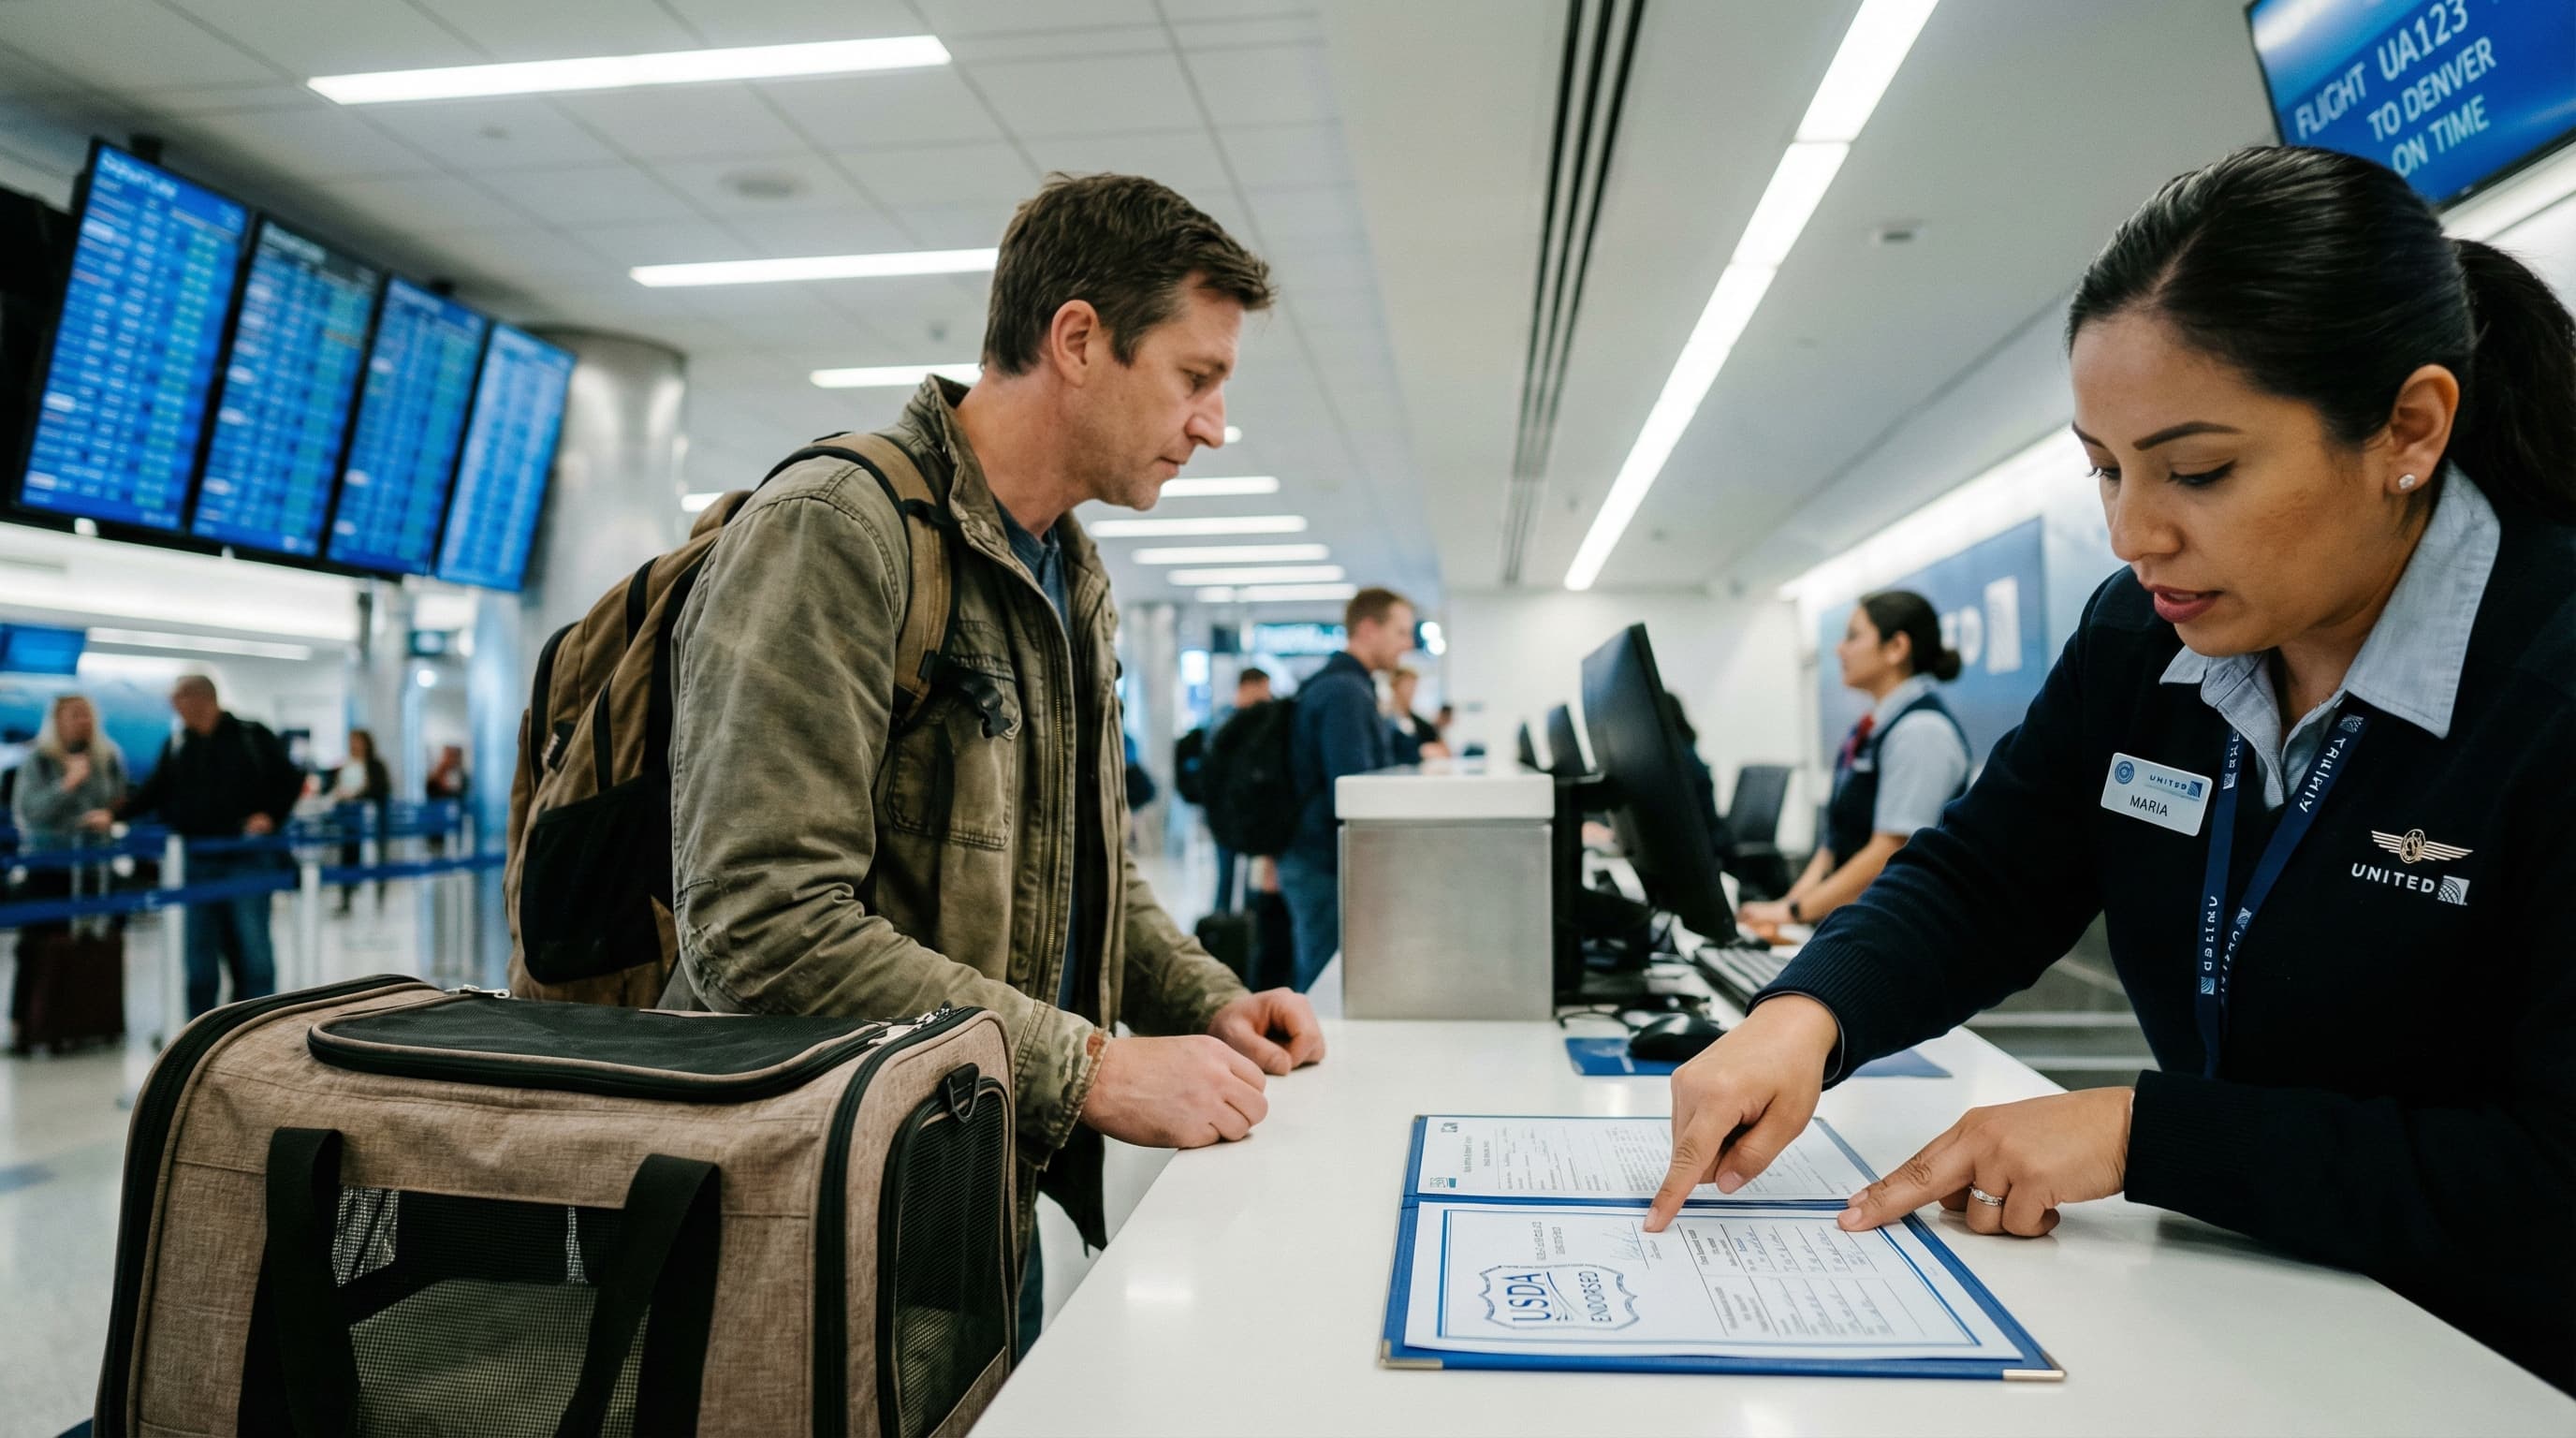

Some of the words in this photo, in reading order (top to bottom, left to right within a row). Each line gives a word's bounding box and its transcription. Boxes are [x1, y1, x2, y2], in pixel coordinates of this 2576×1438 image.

[2294, 61, 2366, 140] FLIGHT
[2377, 0, 2468, 81] UA123
[2366, 100, 2401, 142] TO
[2401, 37, 2496, 124] DENVER
[2392, 134, 2429, 179] ON
[2428, 95, 2490, 154] TIME
[2130, 795, 2168, 816] MARIA
[2149, 774, 2188, 790] UNITED
[2351, 862, 2435, 893] UNITED
[1501, 1271, 1552, 1321] USDA
[1578, 1270, 1612, 1323] ENDORSED
